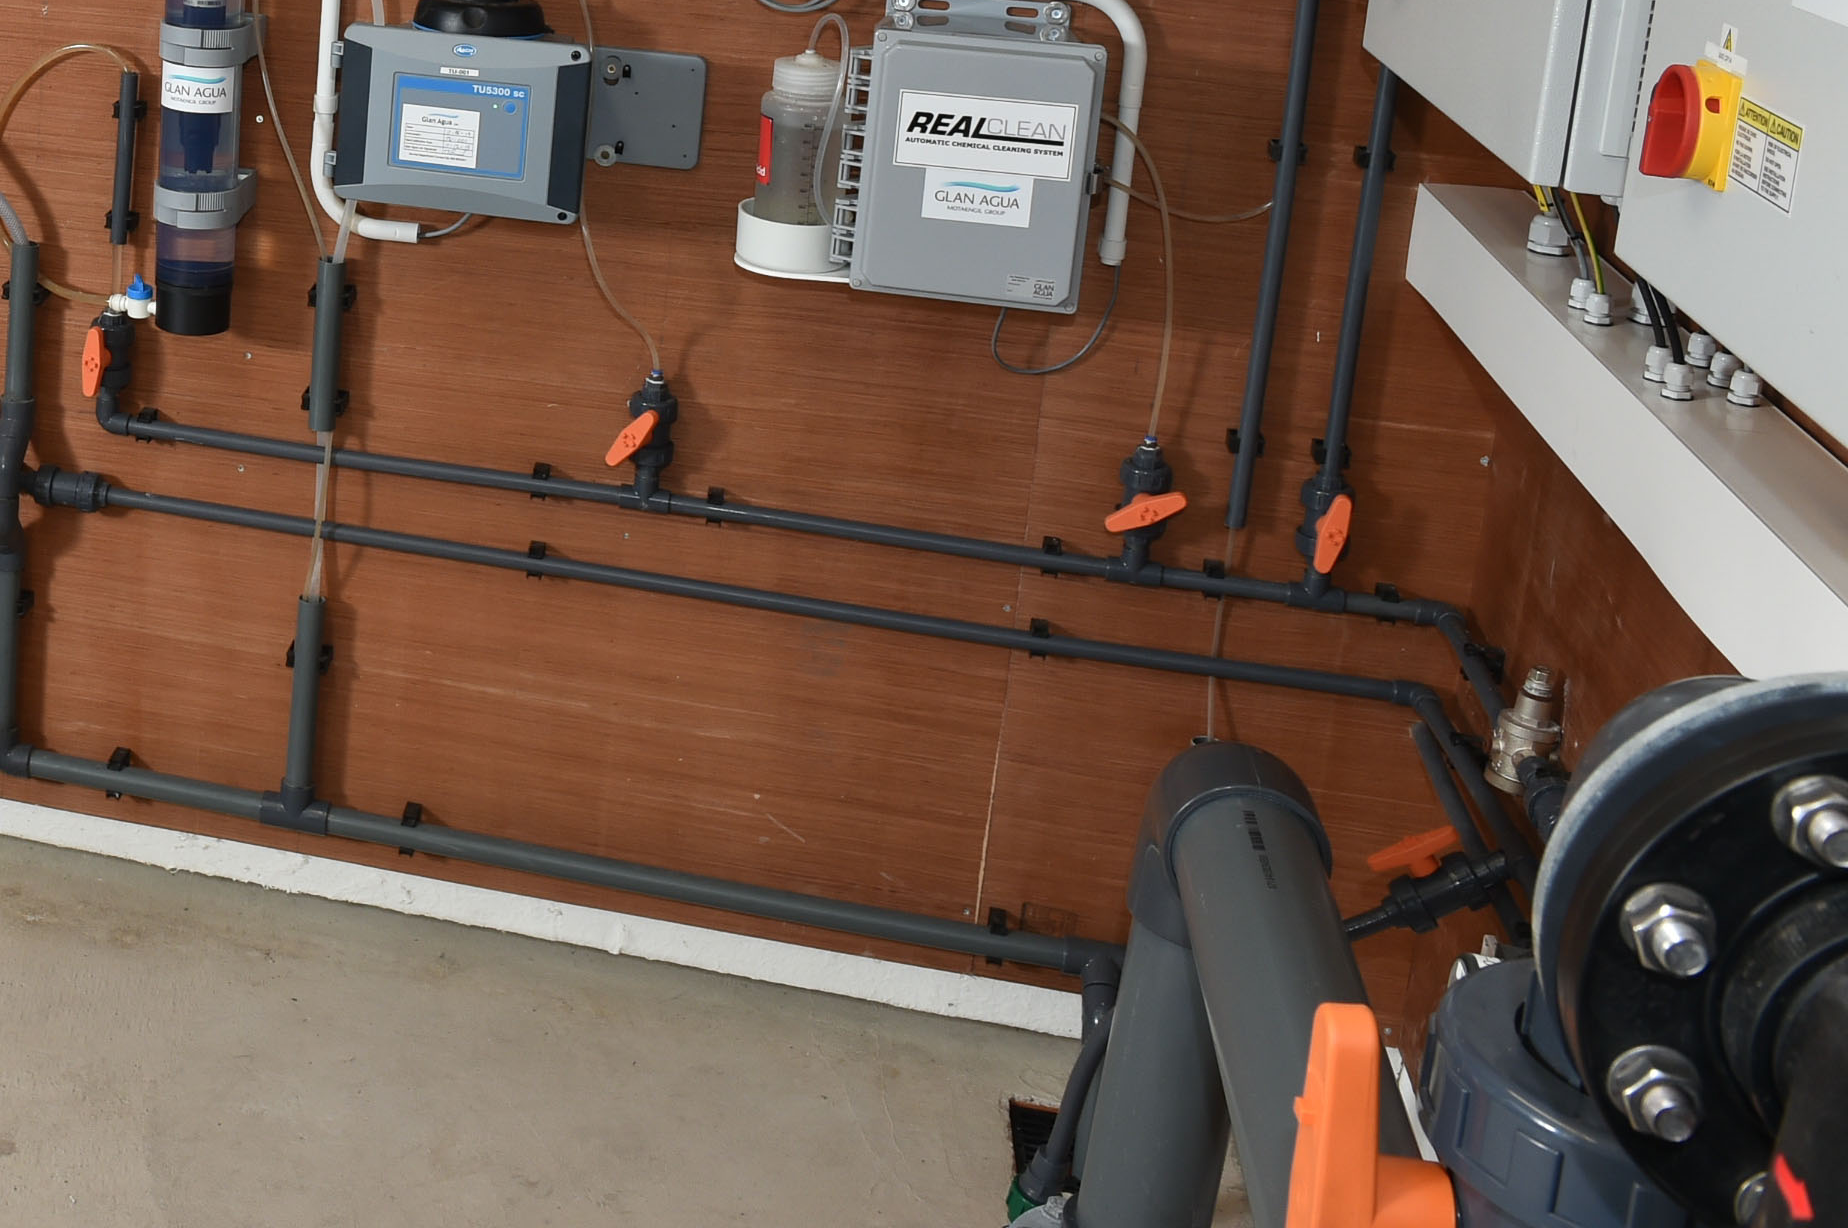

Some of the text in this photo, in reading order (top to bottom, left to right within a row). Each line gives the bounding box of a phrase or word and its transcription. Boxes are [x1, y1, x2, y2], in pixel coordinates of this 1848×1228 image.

[164, 81, 227, 98] GLAN AGUA
[472, 84, 511, 97] TU5300
[421, 115, 453, 126] Glan Agua
[1745, 107, 1800, 145] ATTENTION CAUTION
[905, 136, 1064, 157] AUTOMATIC CHEMICAL CLEANING SYSTEM
[934, 189, 1020, 209] GLAN AGUA
